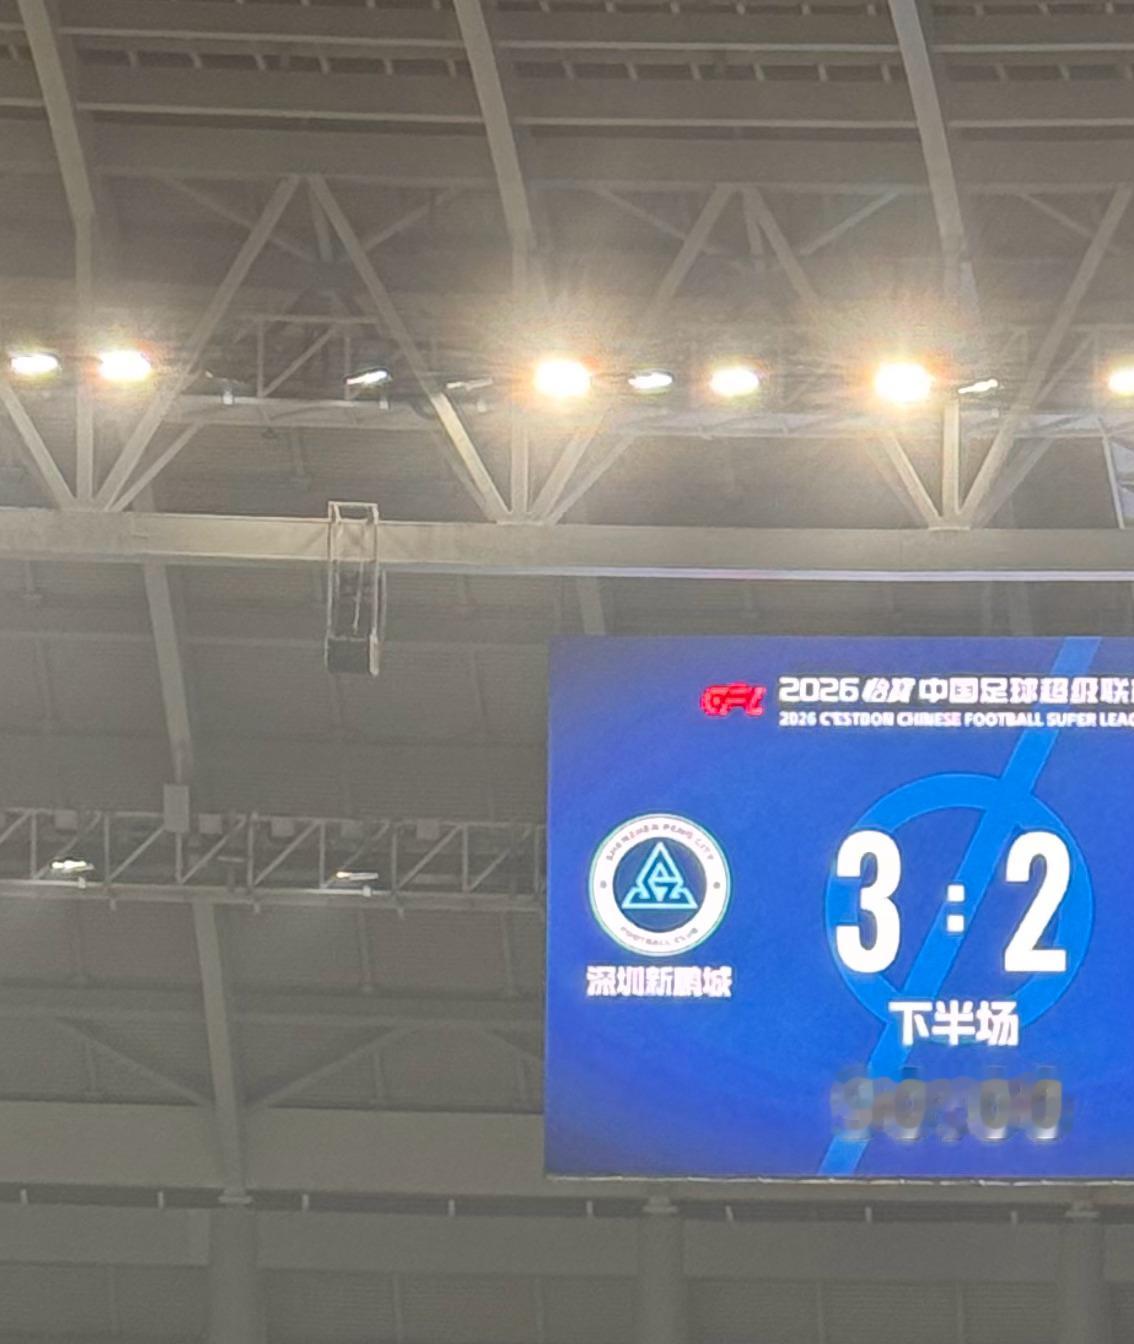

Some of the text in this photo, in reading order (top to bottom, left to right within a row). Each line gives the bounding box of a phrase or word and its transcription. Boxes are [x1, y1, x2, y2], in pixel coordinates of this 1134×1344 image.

[778, 712, 817, 726] 2026
[897, 712, 962, 727] CHINESE
[964, 712, 1044, 727] FOOTBALL
[1046, 712, 1097, 727] SUPER
[836, 830, 901, 973] 3
[1004, 831, 1071, 972] 2
[586, 965, 733, 998] 深圳新鹏城
[888, 1000, 1019, 1046] 下半场
